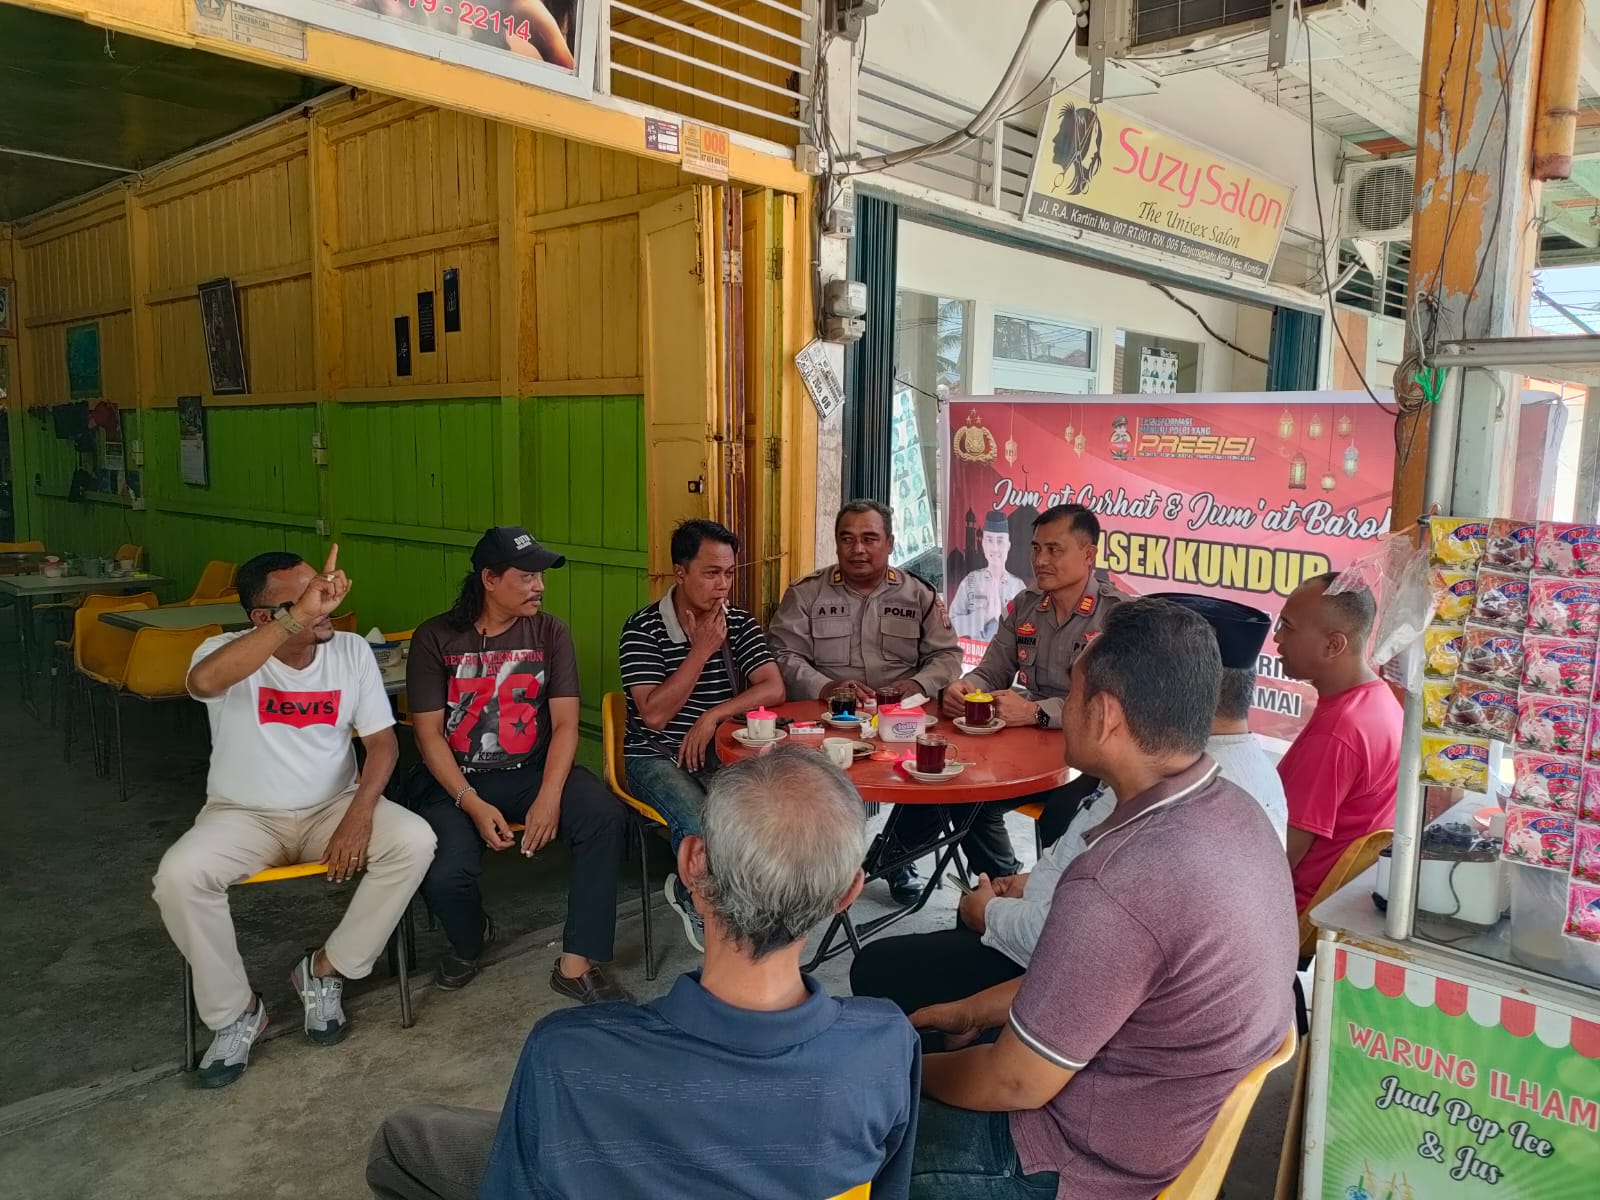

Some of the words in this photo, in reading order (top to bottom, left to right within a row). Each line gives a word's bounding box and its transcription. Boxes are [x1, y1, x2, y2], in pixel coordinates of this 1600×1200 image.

[459, 2, 531, 40] 22114
[1051, 203, 1068, 219] R.A.
[1071, 208, 1098, 228] Kartini
[1098, 216, 1111, 232] No.
[1113, 221, 1128, 236] 007
[1216, 251, 1231, 266] Kota
[1137, 200, 1161, 224] The
[1166, 210, 1209, 238] Unisex
[1209, 224, 1241, 249] Salon
[1138, 434, 1257, 456] PRESISI
[993, 478, 1075, 511] Jum'at
[1074, 484, 1164, 520] Curhat
[1160, 490, 1183, 520] &
[1187, 492, 1303, 532] Jum'at
[884, 606, 916, 619] POLRI
[448, 673, 541, 754] 76
[1348, 1021, 1477, 1088] WARUNG
[1490, 1070, 1600, 1132] ILHAM
[1375, 1075, 1441, 1117] Jual
[1444, 1098, 1504, 1145] Pop
[1508, 1121, 1555, 1158] Ice
[1417, 1131, 1445, 1163] &
[1450, 1146, 1504, 1185] Jus
